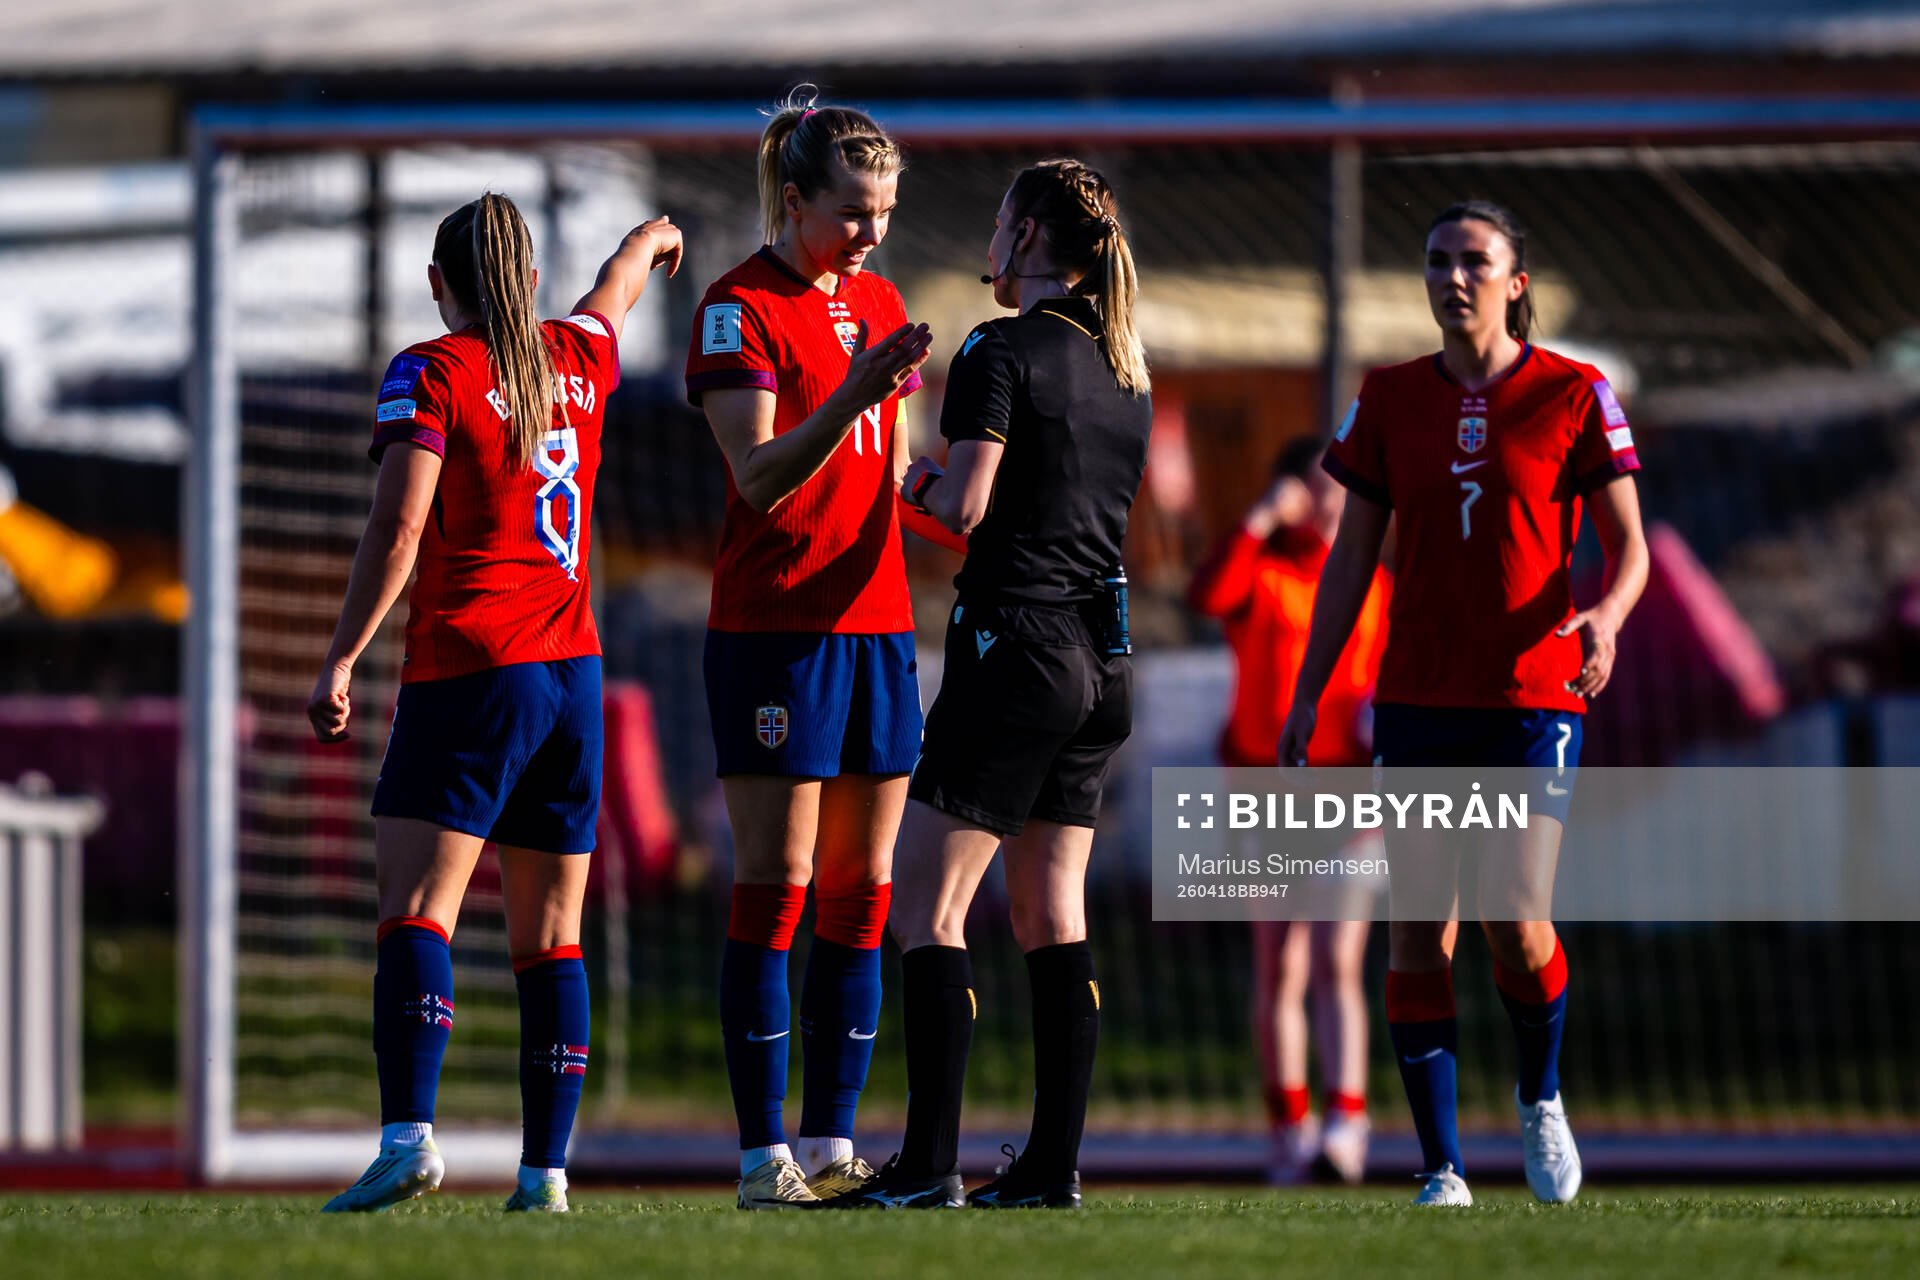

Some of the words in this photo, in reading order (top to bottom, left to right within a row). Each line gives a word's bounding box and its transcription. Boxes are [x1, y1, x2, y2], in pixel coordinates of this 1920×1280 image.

[533, 427, 581, 582] 8
[1460, 481, 1484, 541] 7
[1556, 722, 1572, 777] 7
